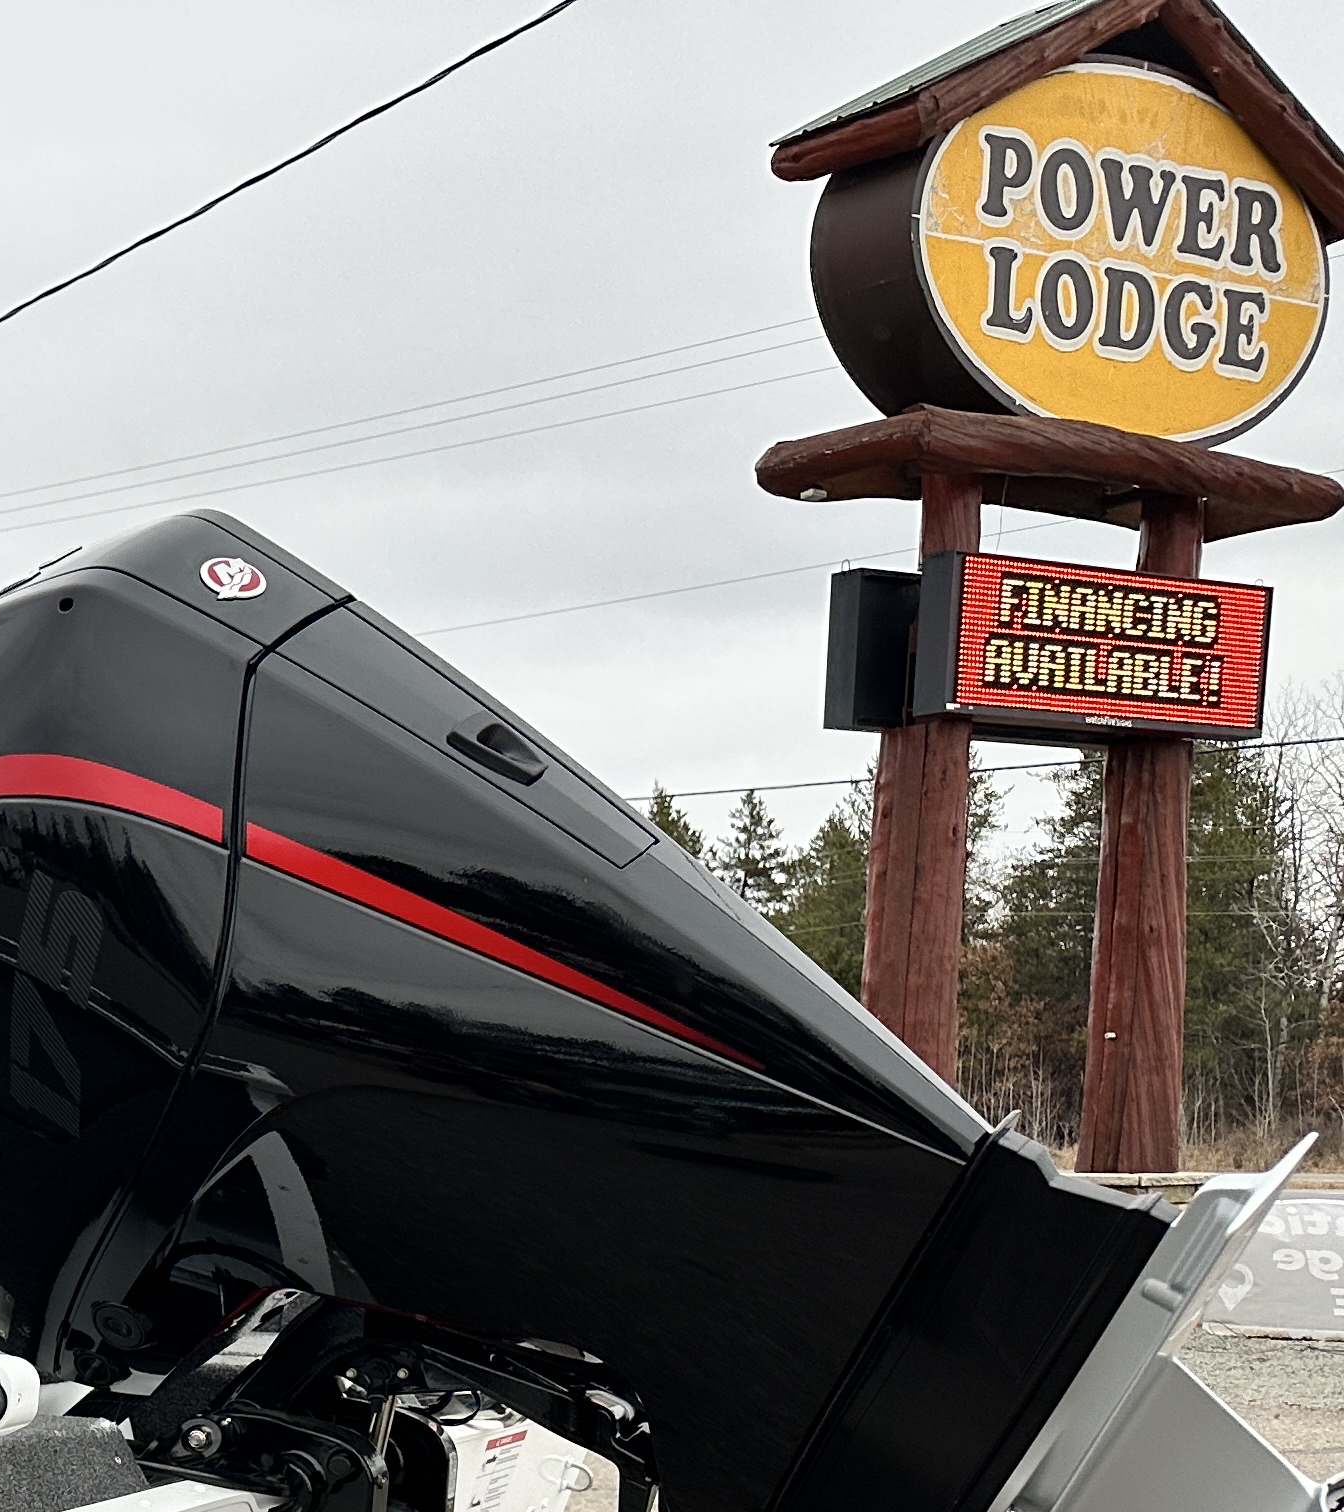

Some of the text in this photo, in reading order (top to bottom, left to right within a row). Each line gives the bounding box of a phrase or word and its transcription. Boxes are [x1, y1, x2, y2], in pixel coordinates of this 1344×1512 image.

[981, 132, 1281, 273] POWER
[985, 246, 1266, 373] LODGE
[999, 578, 1218, 643] FINANCING
[983, 638, 1221, 702] AVAILABLE!
